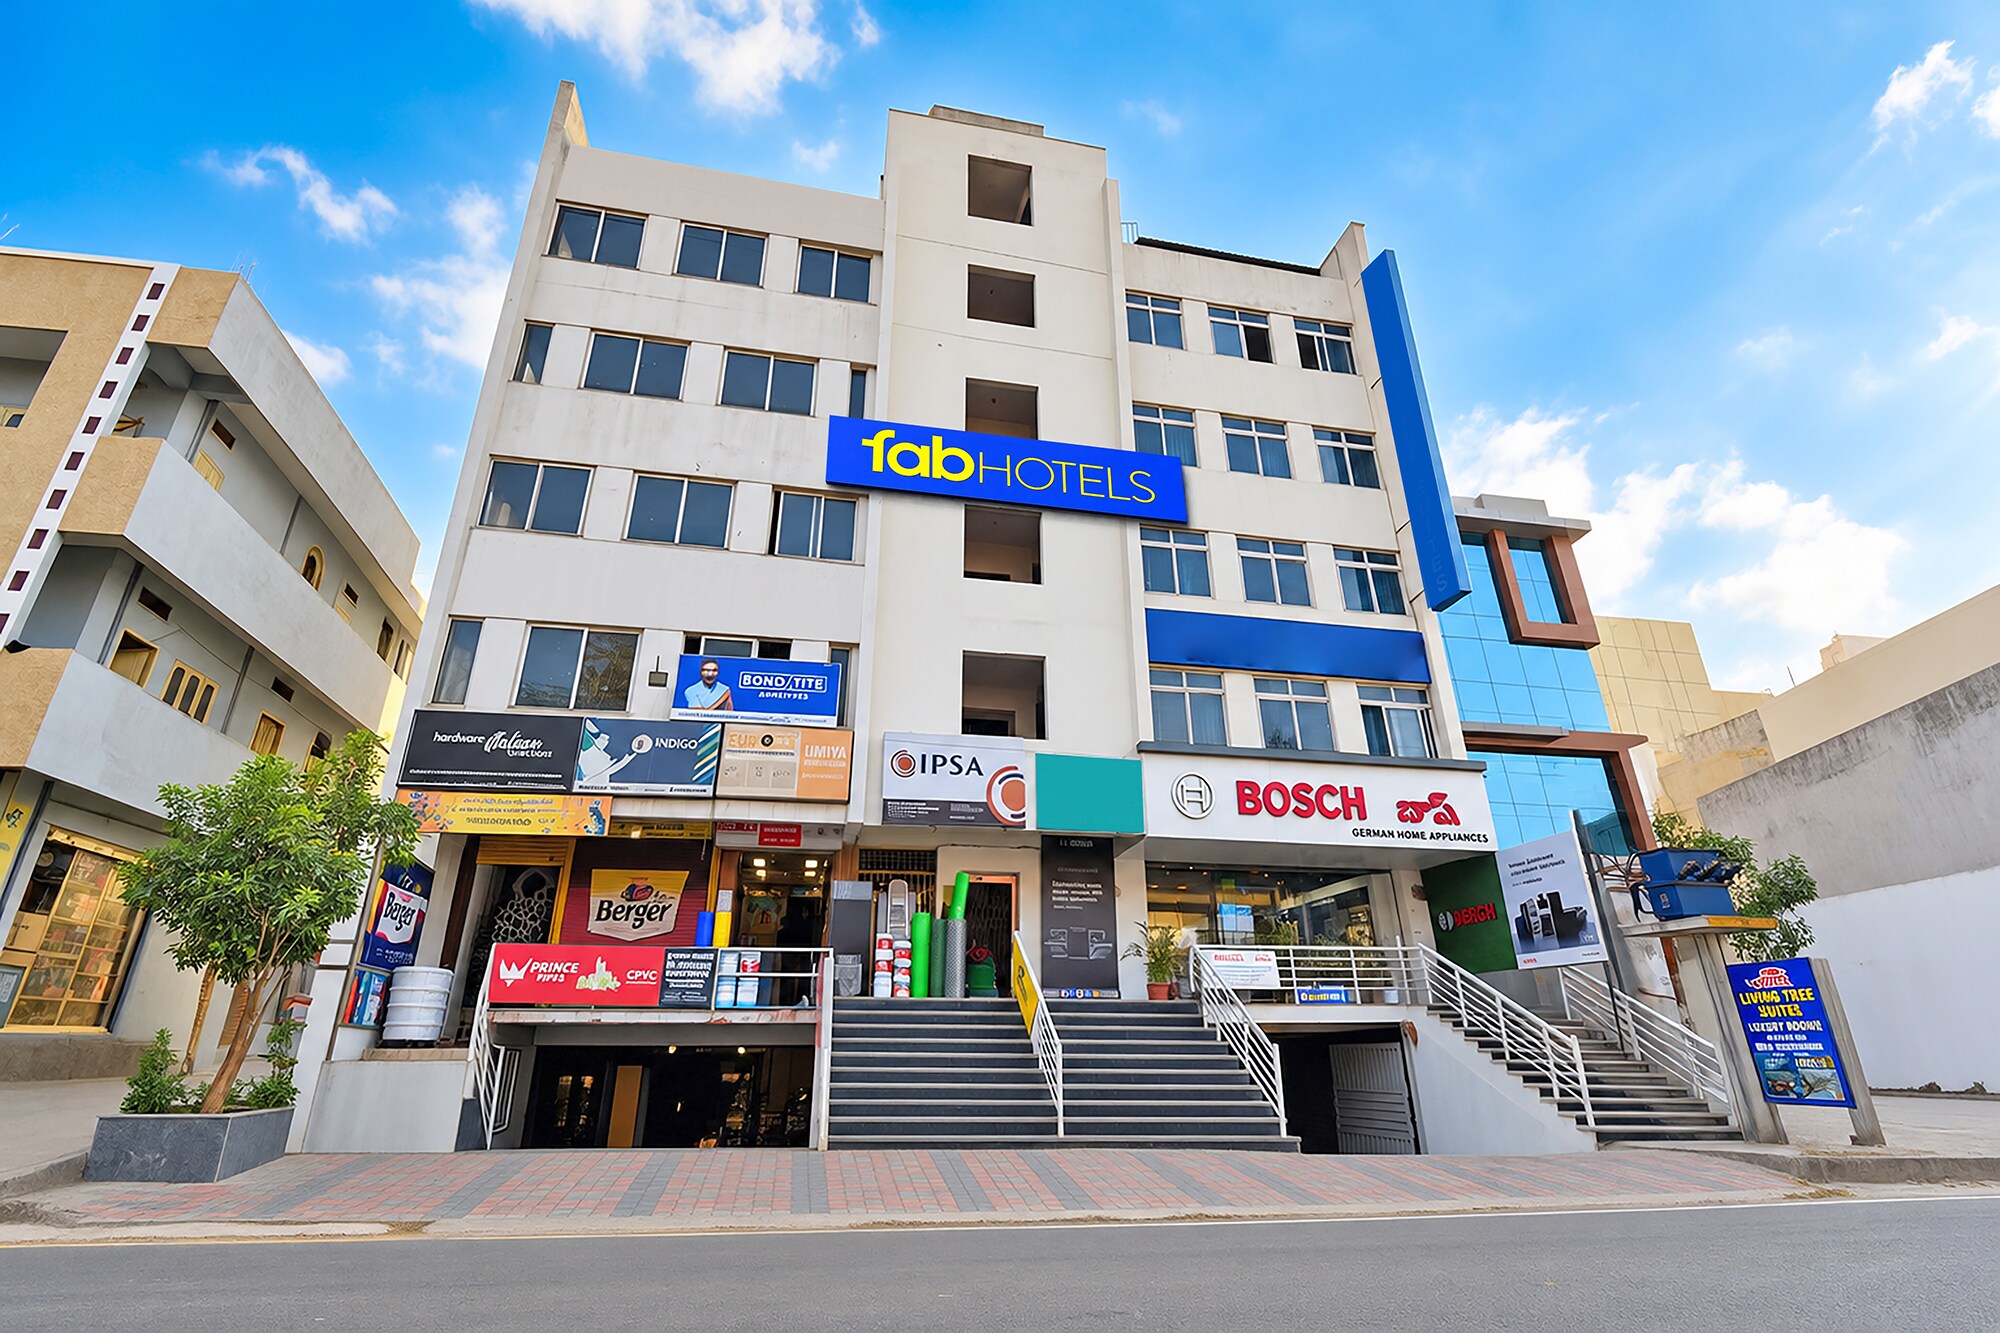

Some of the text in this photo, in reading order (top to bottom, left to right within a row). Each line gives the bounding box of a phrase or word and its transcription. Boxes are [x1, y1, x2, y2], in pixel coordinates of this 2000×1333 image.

[861, 429, 1156, 504] fabHOTELS
[433, 731, 485, 744] hardware
[655, 737, 698, 750] INDIGO
[920, 753, 984, 776] IPSA
[1235, 779, 1368, 821] BOSCH
[1397, 830, 1427, 840] HOME
[1429, 831, 1489, 843] APPLIANCES
[595, 900, 673, 929] Berger
[529, 961, 580, 974] PRINCE
[626, 969, 658, 981] CPVC
[1739, 988, 1815, 1005] LIVING TREE
